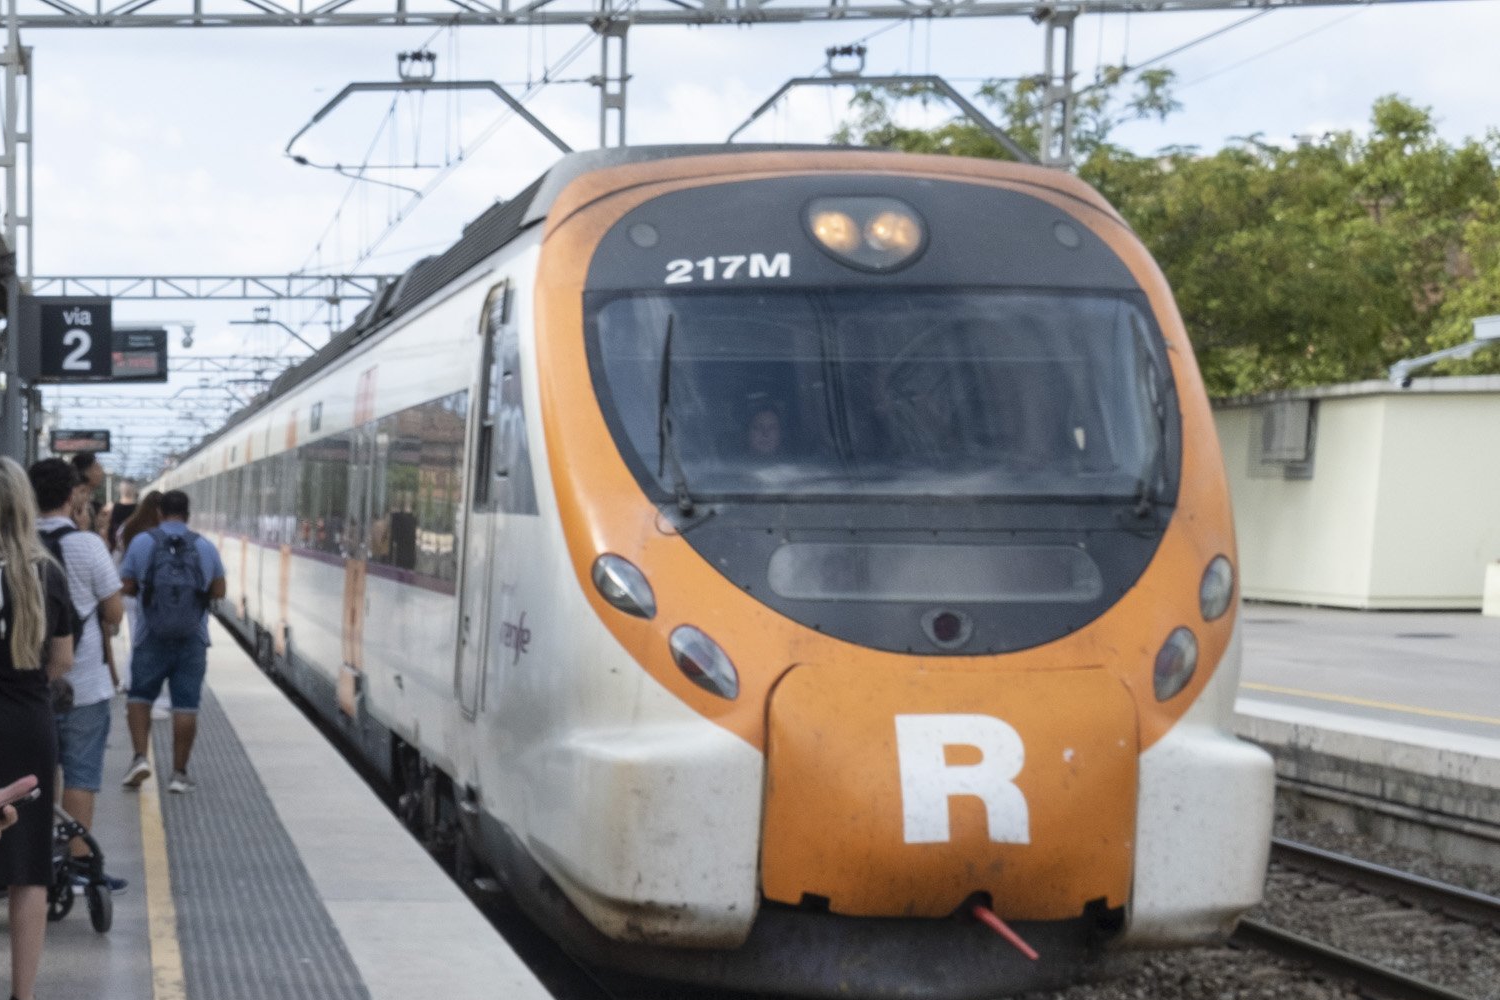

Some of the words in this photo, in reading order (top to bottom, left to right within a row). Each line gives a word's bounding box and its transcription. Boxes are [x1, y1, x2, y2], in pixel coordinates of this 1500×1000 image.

[664, 252, 791, 285] 217M
[62, 306, 92, 326] via
[62, 329, 92, 370] 2
[894, 713, 1032, 845] R
